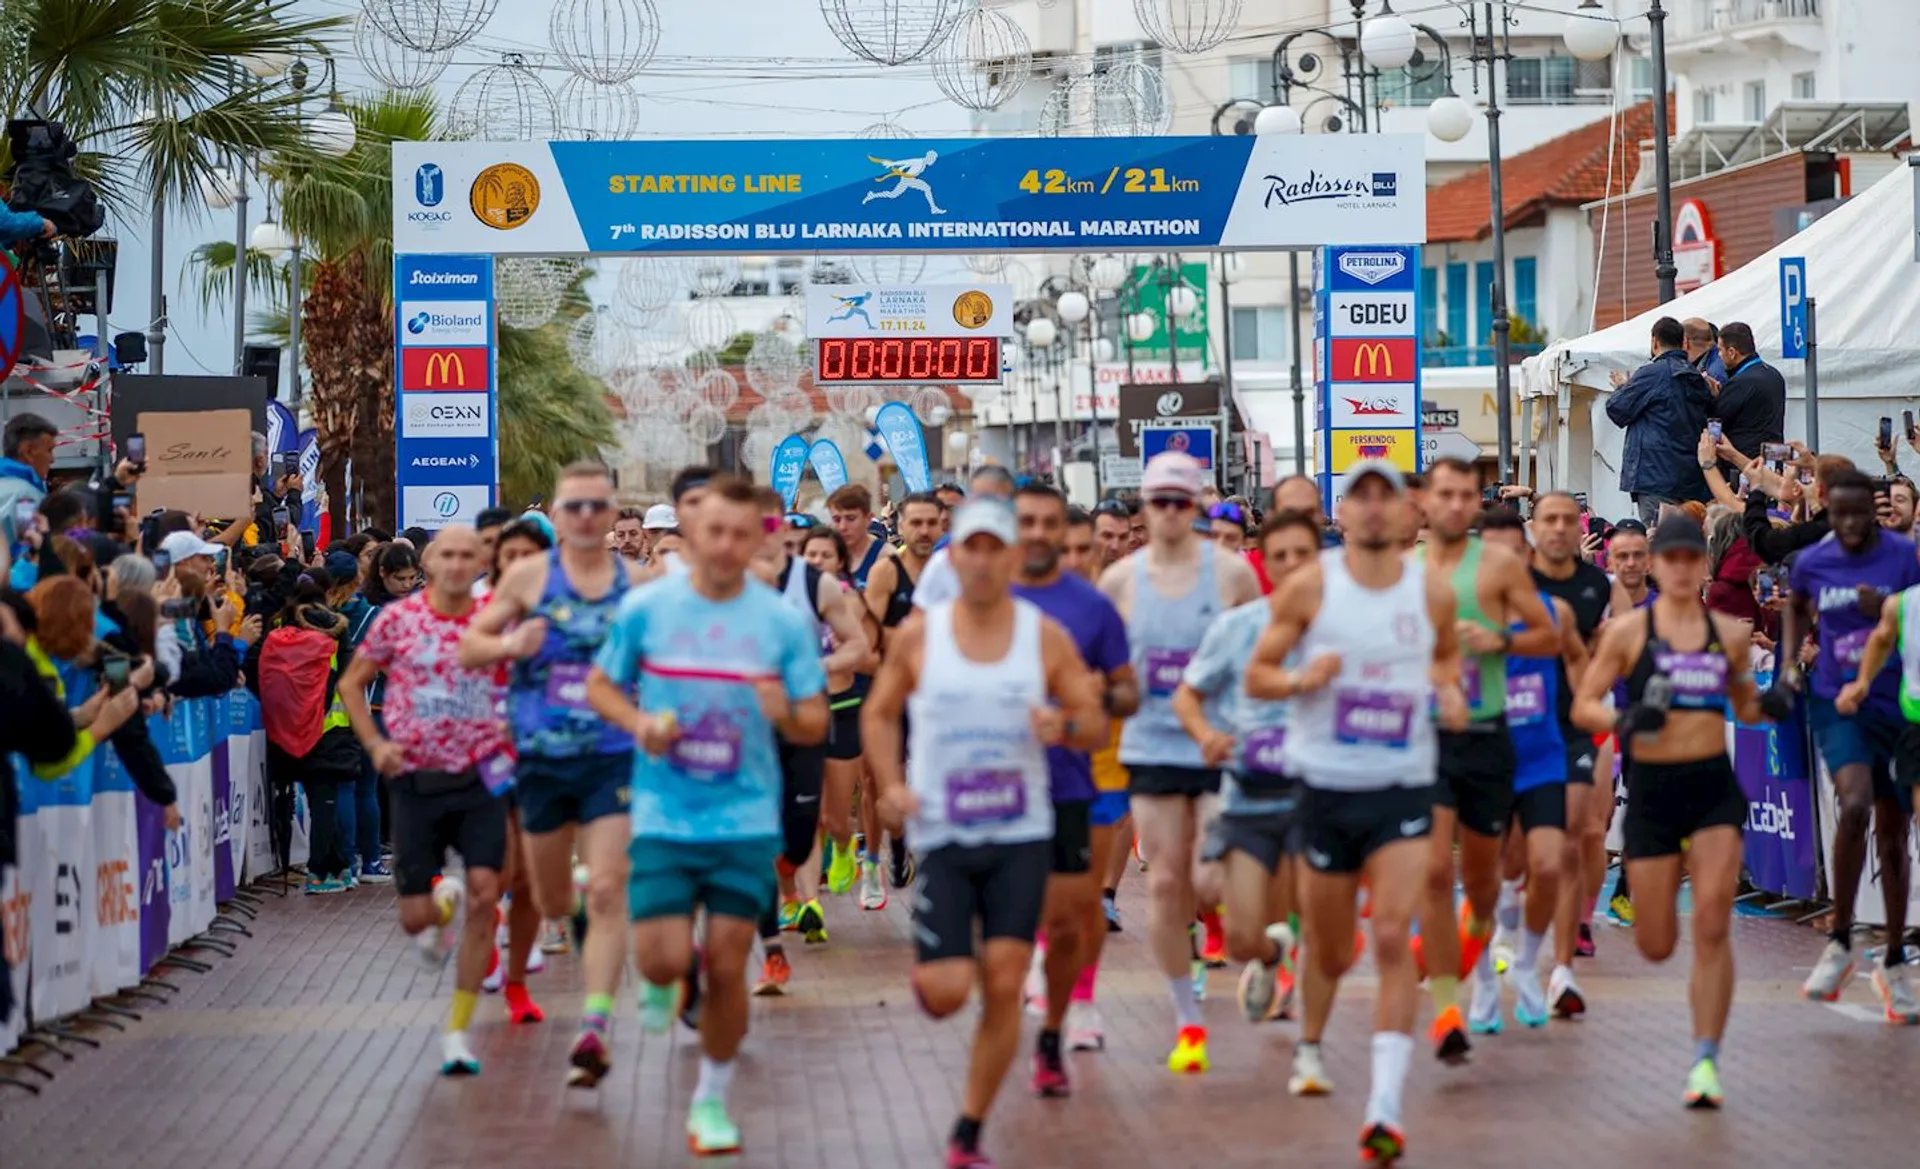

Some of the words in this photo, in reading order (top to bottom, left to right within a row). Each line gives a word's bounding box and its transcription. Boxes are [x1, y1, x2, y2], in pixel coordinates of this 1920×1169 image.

[609, 175, 737, 194] STARTING
[744, 174, 803, 194] LINE
[1019, 169, 1095, 195] 42km
[1124, 167, 1200, 194] 21km
[1263, 170, 1369, 210] Radisson
[610, 224, 636, 240] 7th
[641, 223, 750, 240] RADISSON
[755, 222, 796, 239] BLU
[801, 222, 902, 239] LARNAKA
[908, 220, 1075, 238] INTERNATIONAL
[1080, 219, 1200, 236] MARATHON
[1346, 257, 1398, 267] PETROLINA
[410, 270, 478, 285] Stoiximan
[1784, 264, 1801, 327] P
[432, 314, 482, 326] Bioland
[880, 320, 926, 331] 17.11.24
[823, 341, 989, 378] 00:00:00
[1360, 397, 1397, 411] ACS
[1349, 434, 1397, 444] PERSKINDOL
[411, 457, 468, 466] AEGEAN
